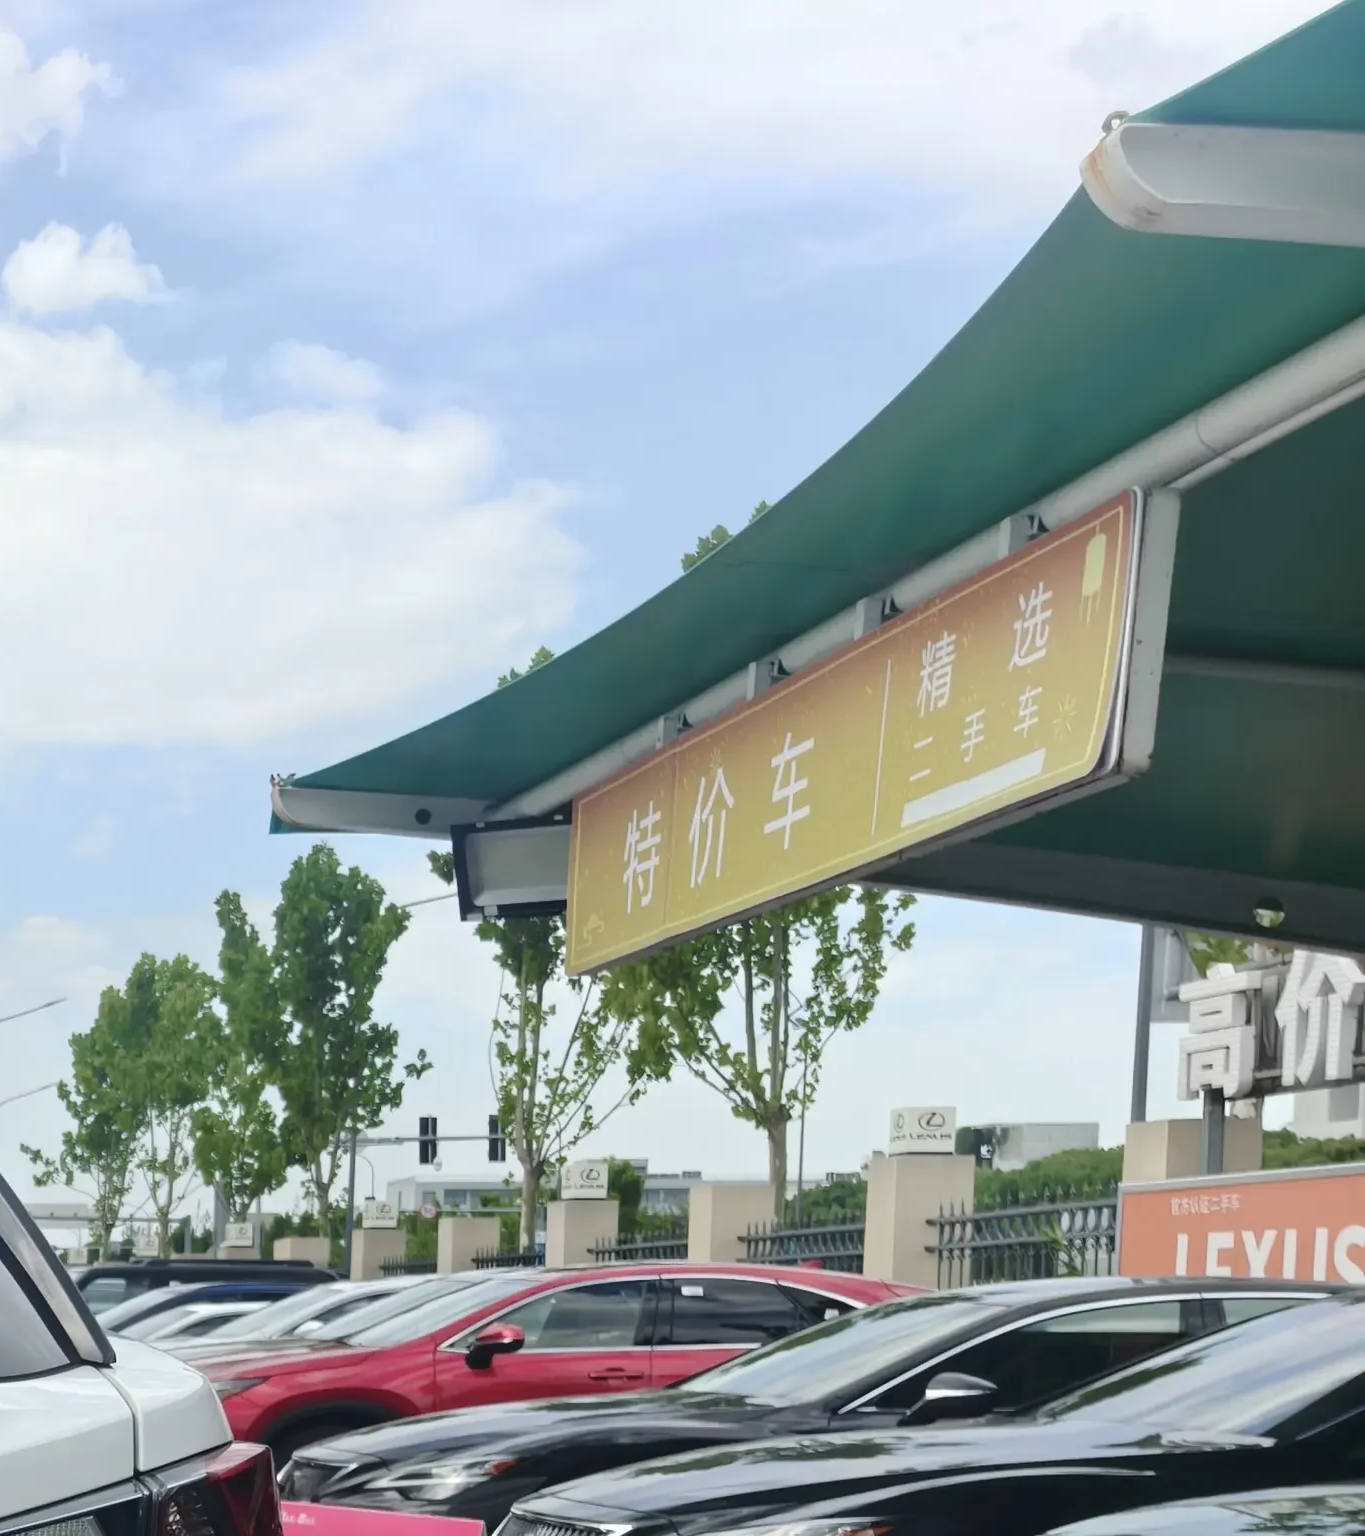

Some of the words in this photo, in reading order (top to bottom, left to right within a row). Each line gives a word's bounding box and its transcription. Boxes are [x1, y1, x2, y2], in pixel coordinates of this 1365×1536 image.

[918, 581, 1054, 718] 精选
[910, 686, 1044, 783] 二手车
[622, 731, 816, 915] 特价车
